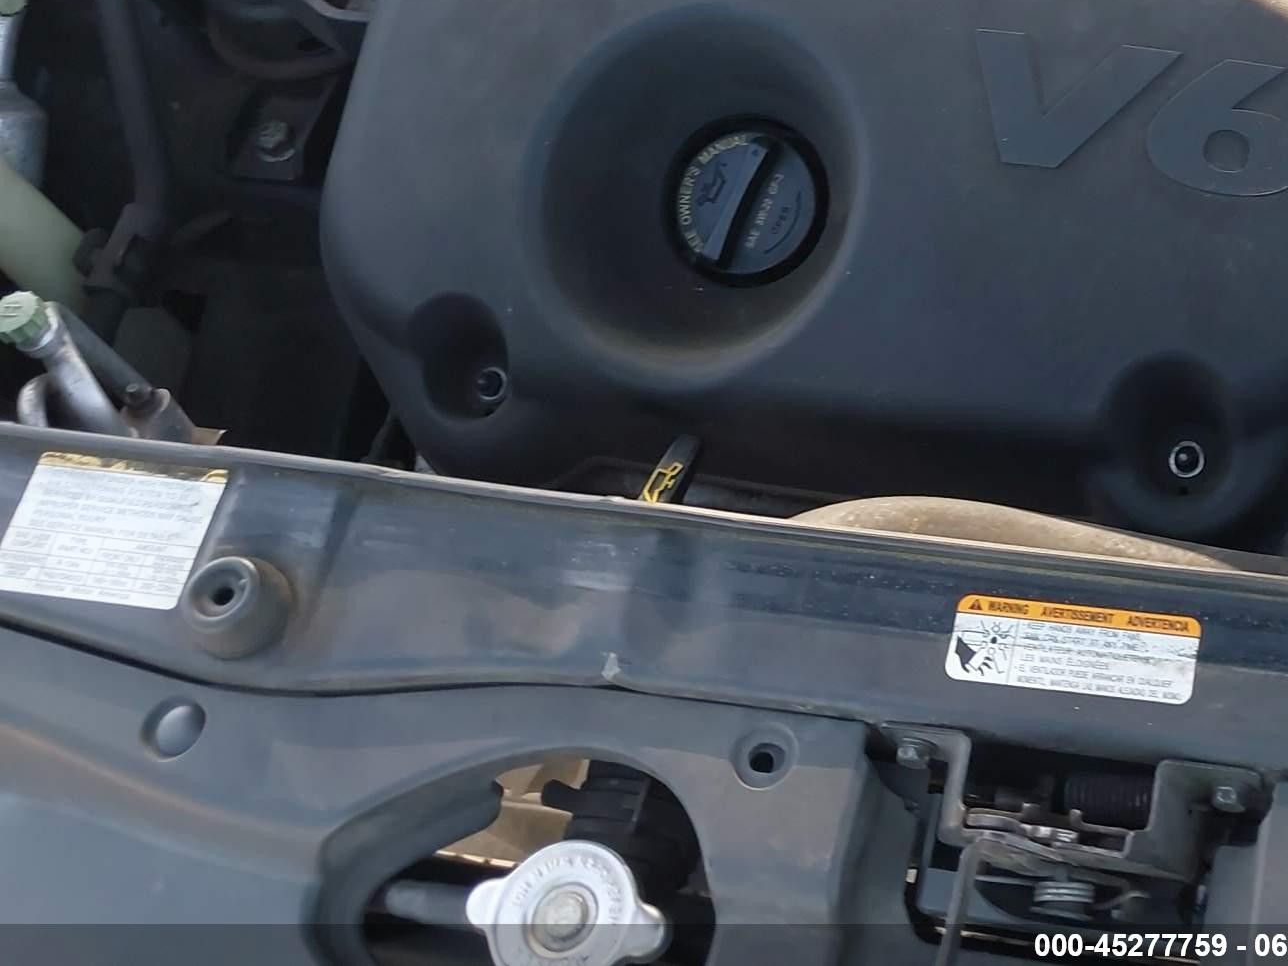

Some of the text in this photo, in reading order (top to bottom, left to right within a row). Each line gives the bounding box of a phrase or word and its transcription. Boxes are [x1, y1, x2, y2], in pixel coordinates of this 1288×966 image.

[987, 599, 1190, 634] WARNING AVERTISSEMENT ADVERTENCIA
